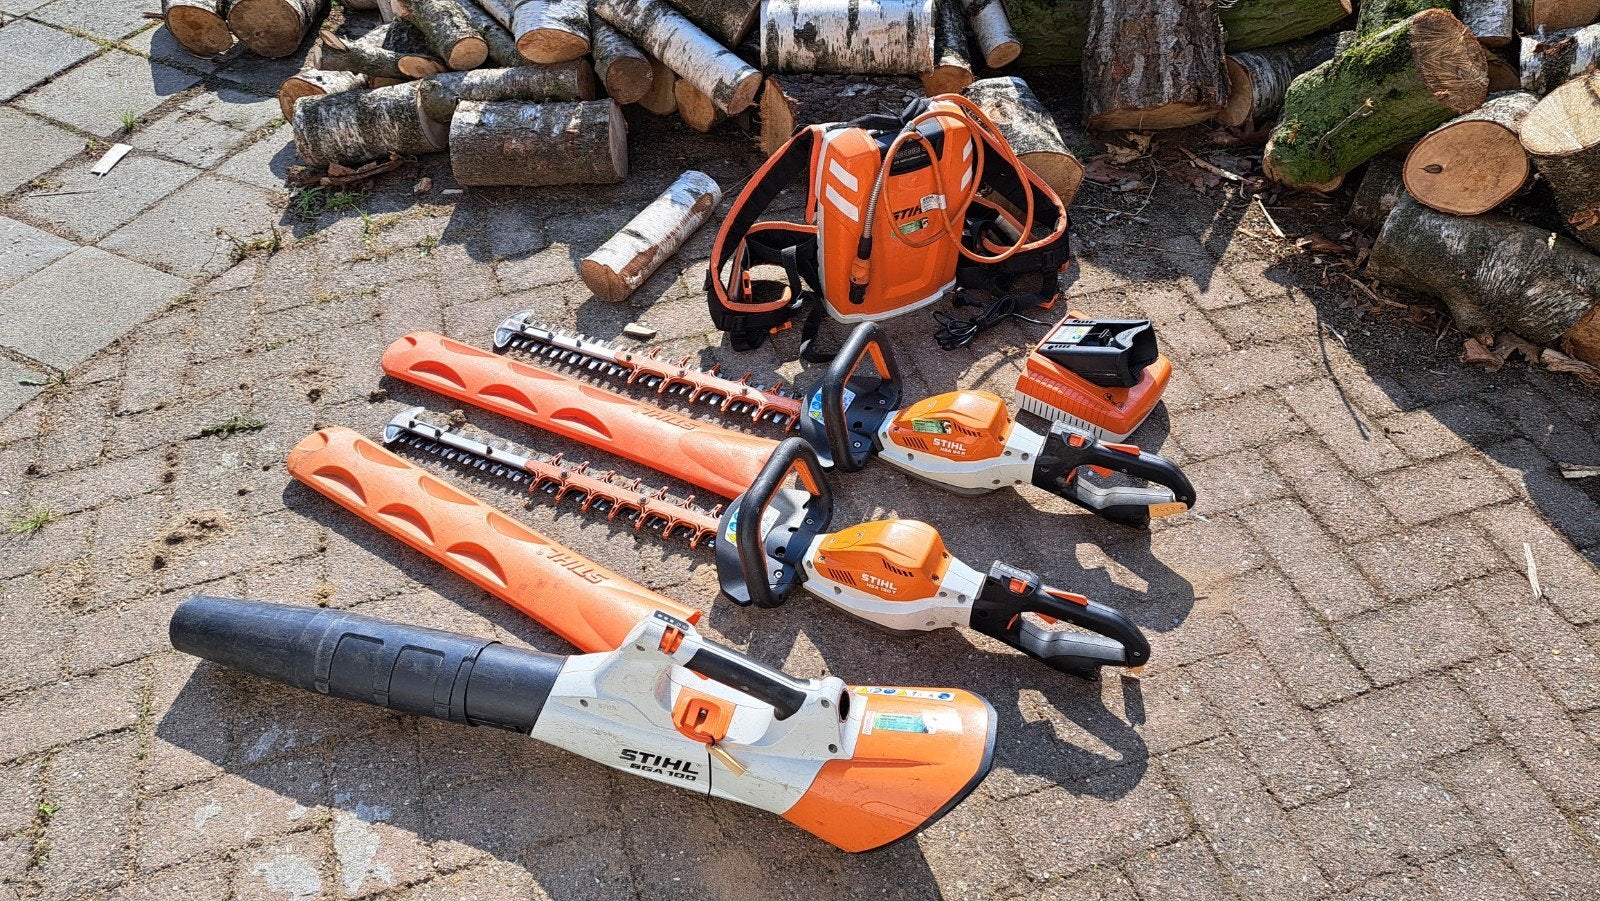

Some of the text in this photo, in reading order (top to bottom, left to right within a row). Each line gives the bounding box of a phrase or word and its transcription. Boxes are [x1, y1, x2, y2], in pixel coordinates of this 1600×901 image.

[641, 407, 700, 431] STIHL
[933, 437, 966, 451] STIHL
[547, 548, 610, 584] STIHL
[861, 573, 897, 590] STIHL
[619, 748, 699, 775] STIHL
[630, 763, 697, 781] BGA 100
